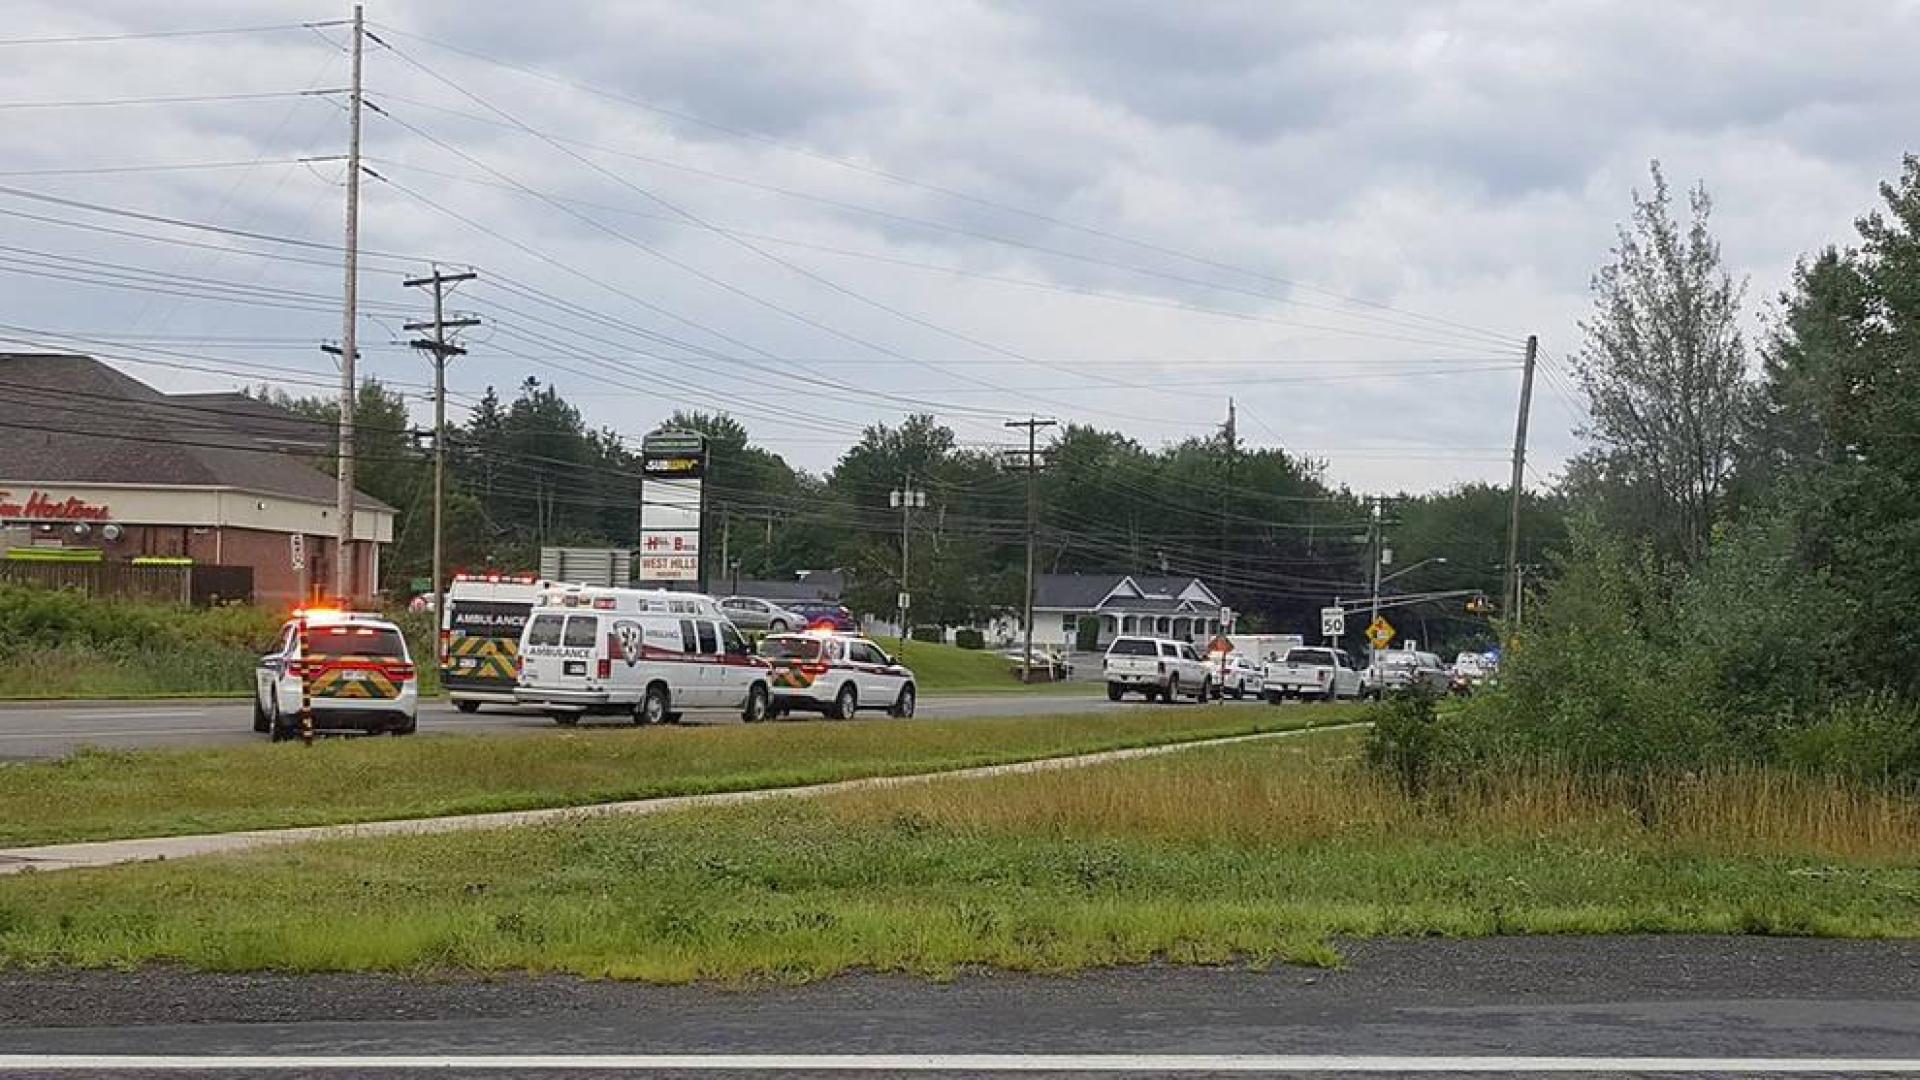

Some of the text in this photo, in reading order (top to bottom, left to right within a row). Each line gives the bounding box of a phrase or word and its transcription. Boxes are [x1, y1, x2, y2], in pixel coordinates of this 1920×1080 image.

[23, 489, 110, 520] Hortons
[1324, 618, 1343, 633] 50
[528, 646, 591, 658] AMBULANCE
